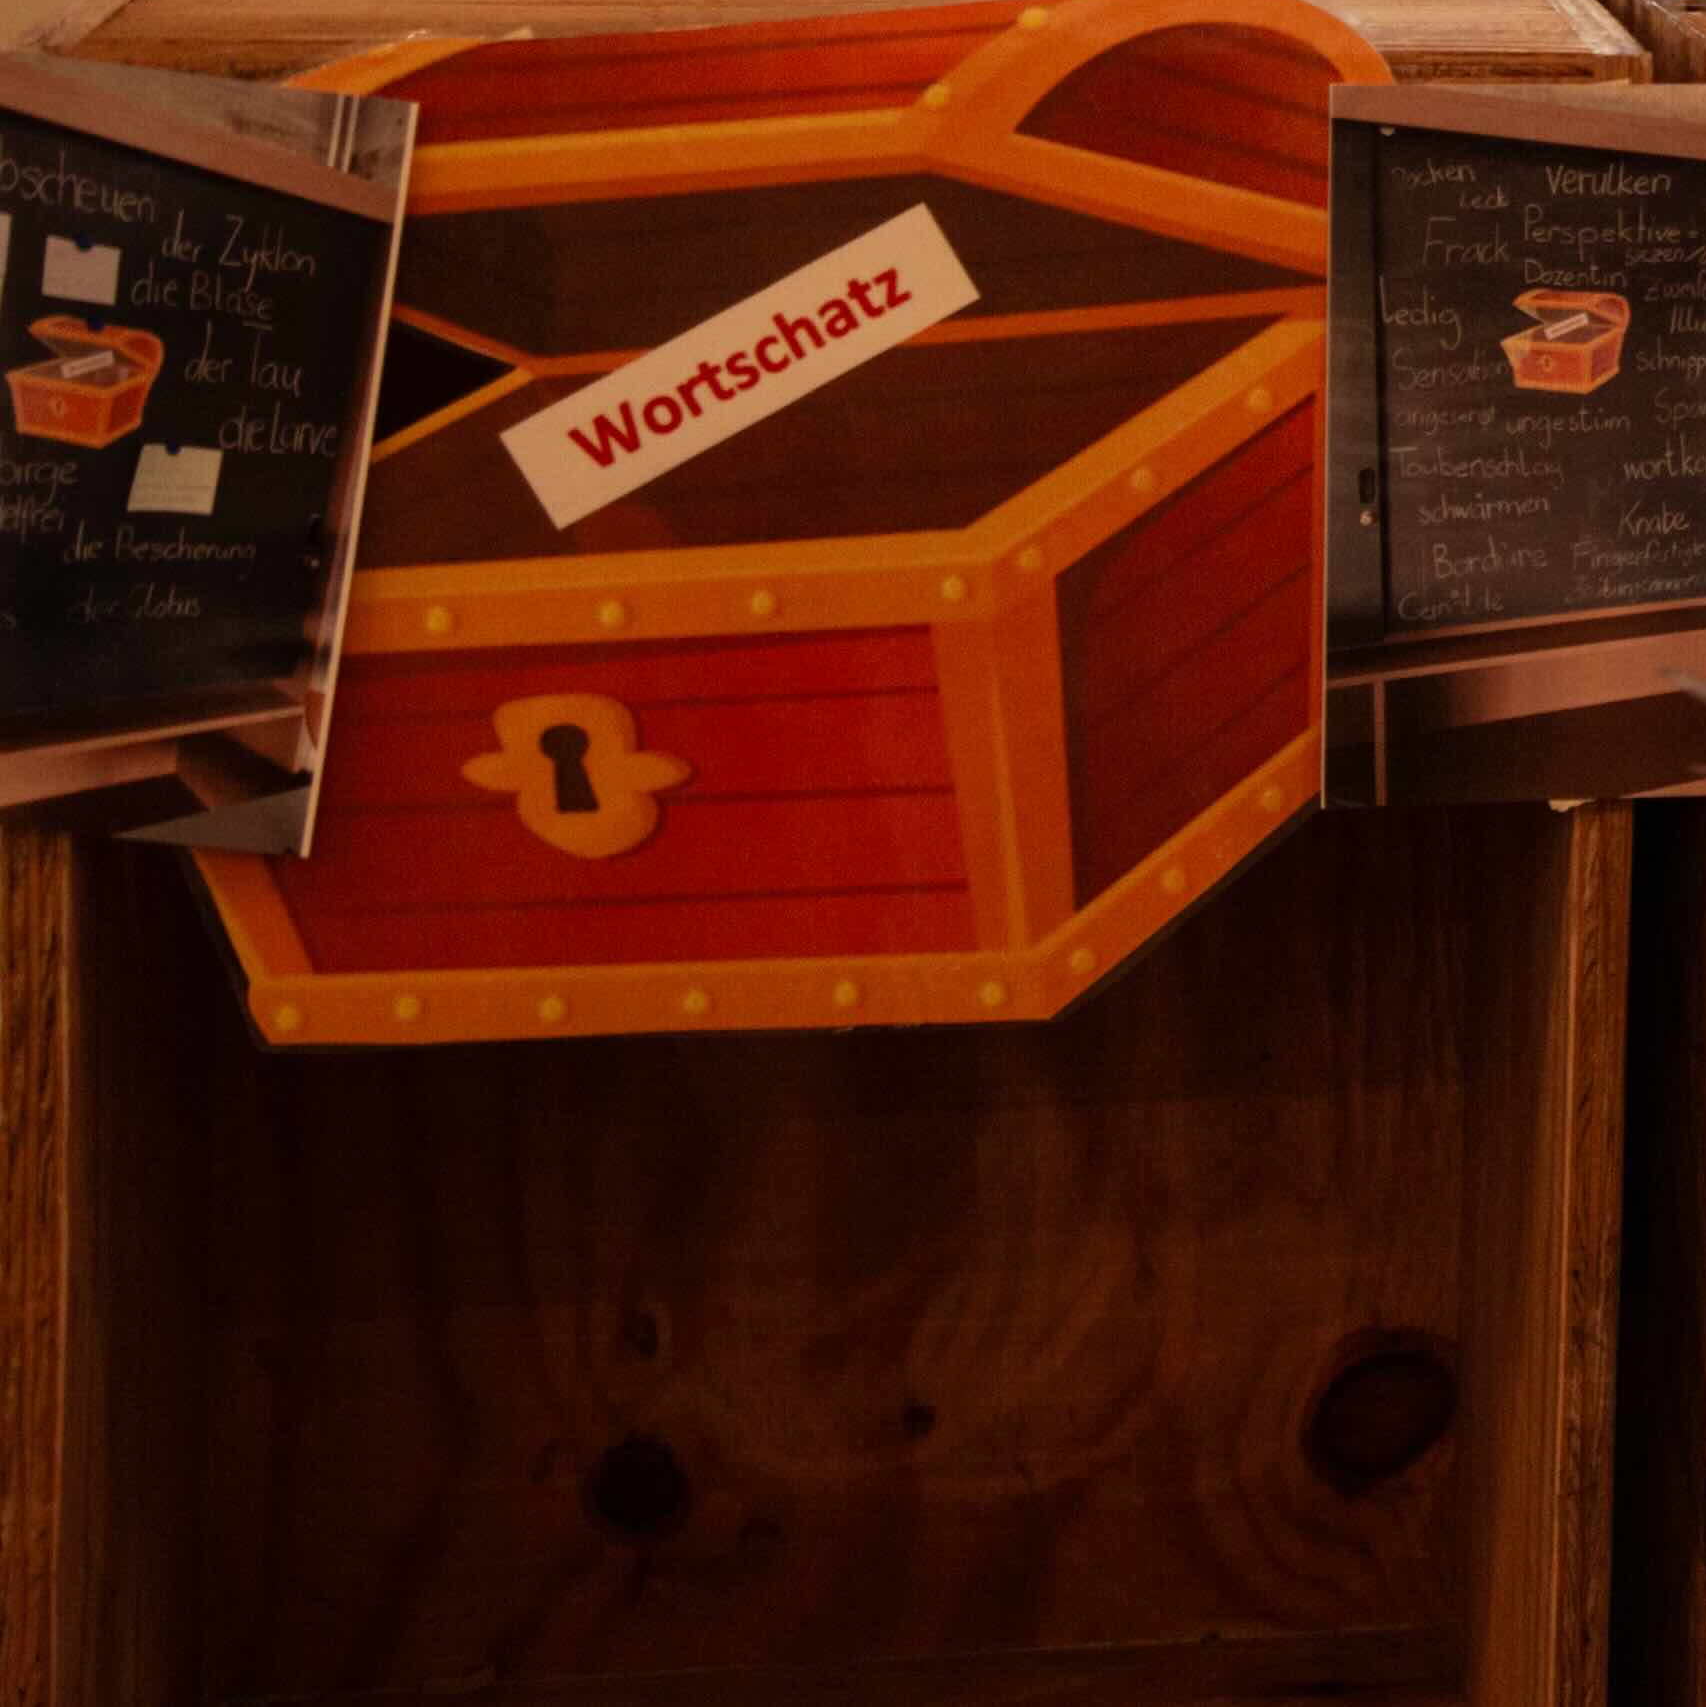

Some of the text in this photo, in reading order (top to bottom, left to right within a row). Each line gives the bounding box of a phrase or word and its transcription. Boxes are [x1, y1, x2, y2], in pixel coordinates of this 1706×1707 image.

[162, 208, 317, 292] der Zyklon
[1422, 215, 1511, 266] Frack
[1522, 203, 1681, 263] Perspektive
[131, 258, 274, 322] die Blase
[1523, 258, 1628, 289] Dozentin
[184, 321, 233, 383] der
[568, 267, 912, 469] Wortschatz
[219, 400, 338, 457] die Larve
[1388, 445, 1565, 485] Taubenschlag
[1417, 492, 1551, 526] schwärmen
[1617, 498, 1692, 538] Knabe
